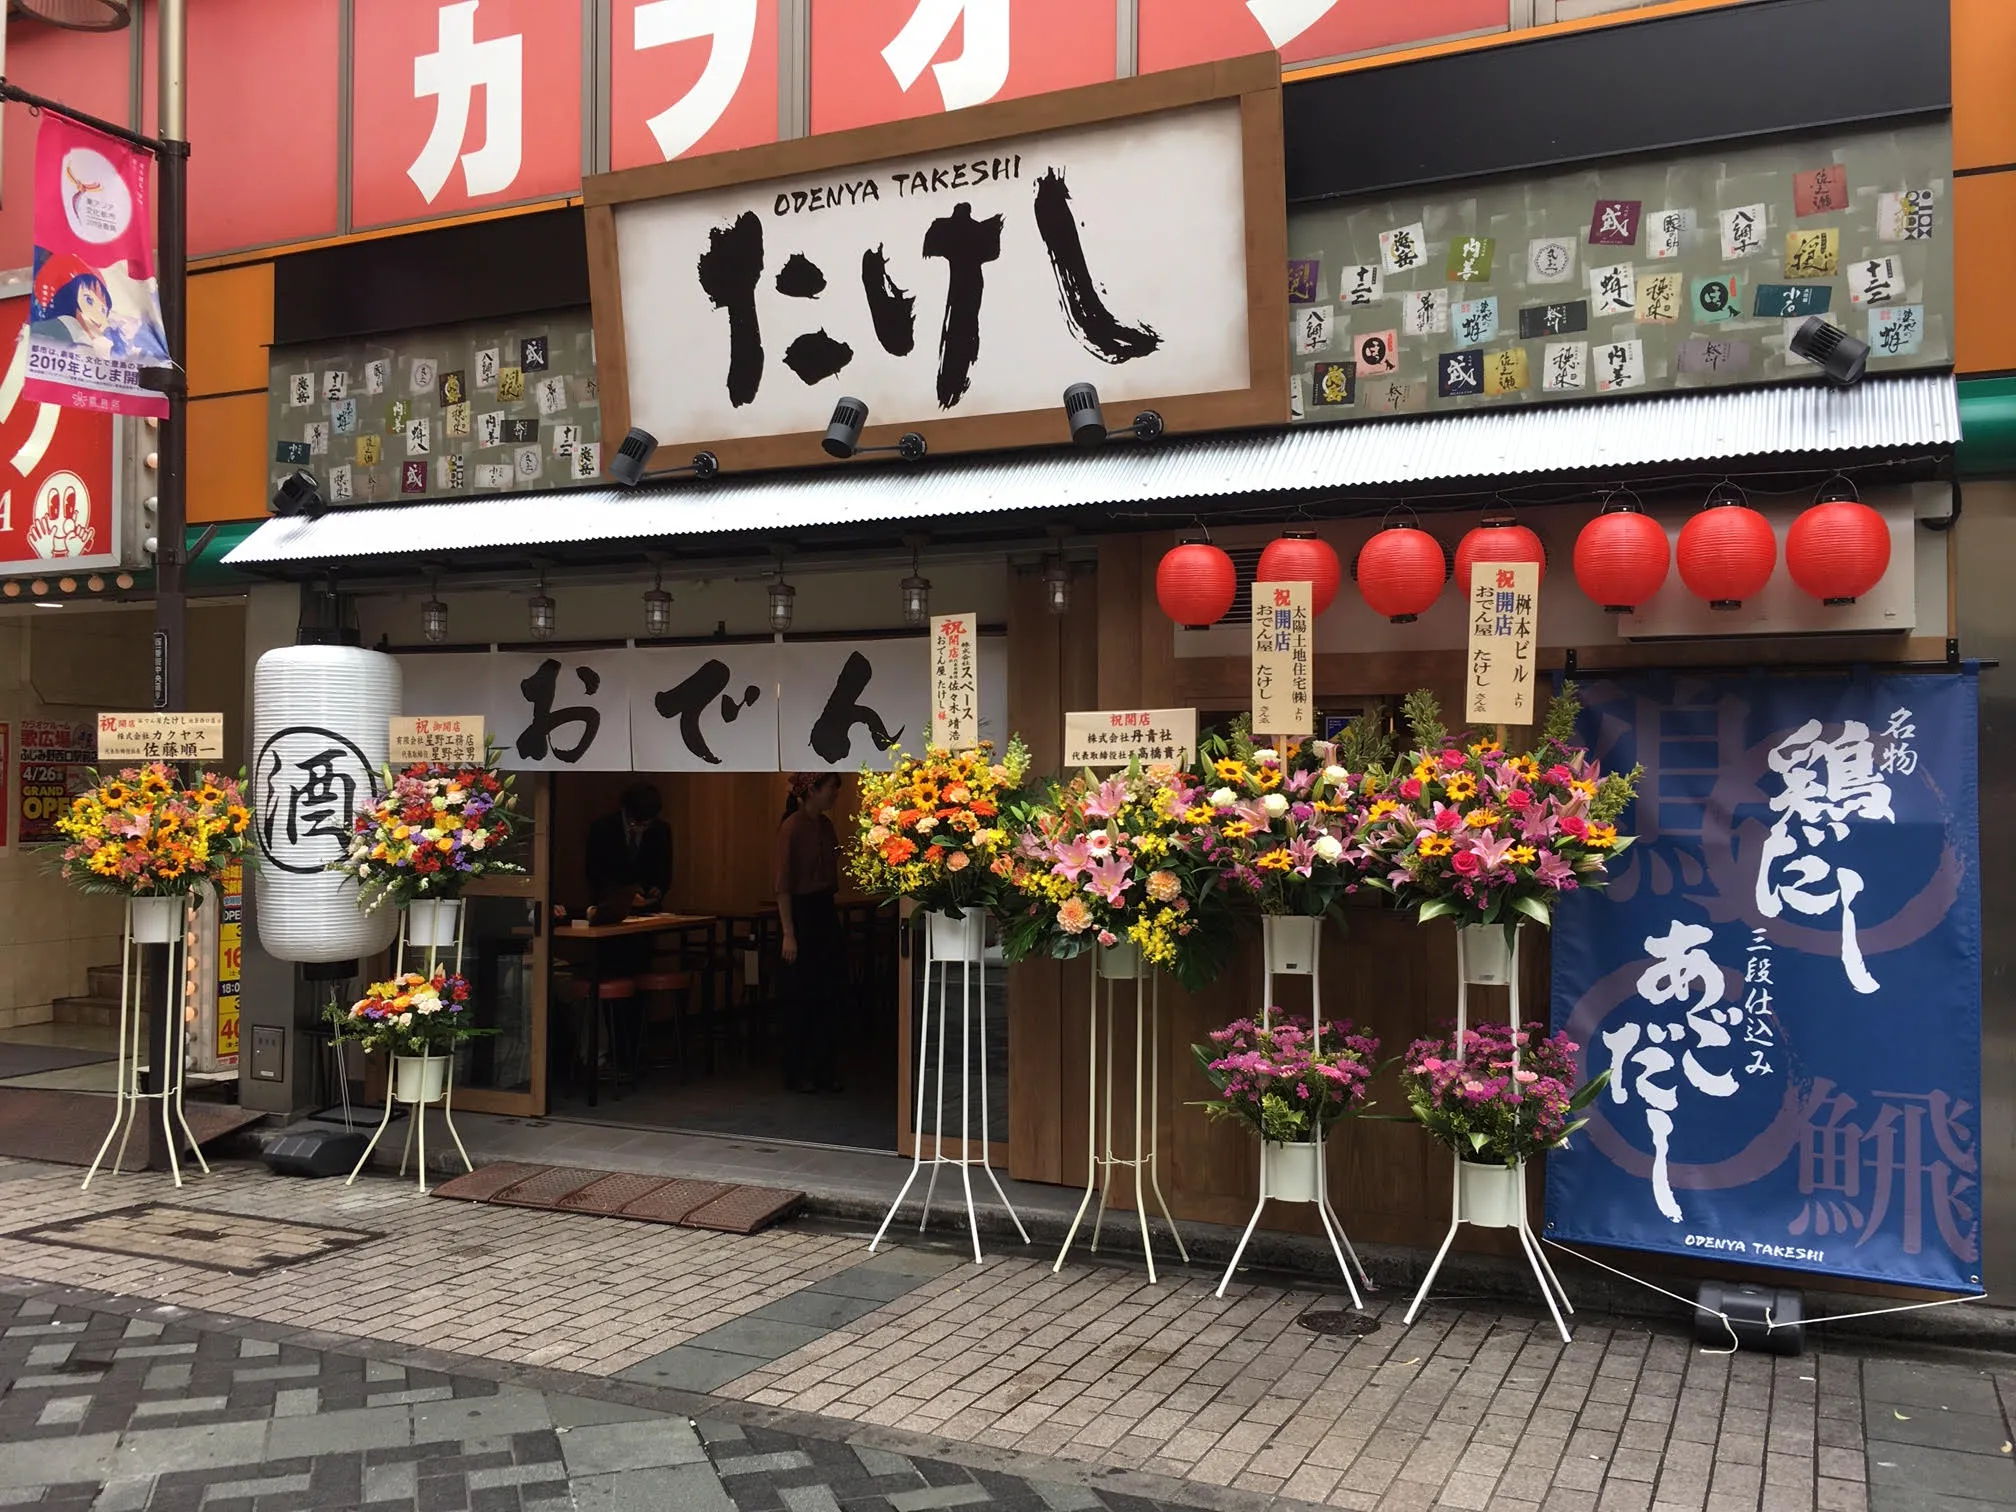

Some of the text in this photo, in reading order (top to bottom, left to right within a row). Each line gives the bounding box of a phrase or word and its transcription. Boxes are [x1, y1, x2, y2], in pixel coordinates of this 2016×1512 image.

[774, 155, 1021, 216] ODENYA TAKESHI
[697, 166, 1165, 411] たけし
[1474, 586, 1494, 637] おでん屋
[1494, 569, 1515, 636] 祝 開店
[941, 619, 967, 636] 祝
[1256, 605, 1273, 652] おでん屋
[1273, 588, 1291, 651] 祝 開店
[937, 635, 946, 676] おでん屋
[948, 635, 959, 659] 開店
[1513, 594, 1532, 708] 桝本ビル より
[1257, 664, 1273, 700] たけし
[1473, 650, 1491, 687] たけし
[516, 651, 905, 764] おでん
[938, 680, 946, 709] たけし
[948, 681, 960, 714] 佐々木
[100, 716, 117, 732] 祝
[416, 718, 461, 734] 祝 御開店
[1110, 712, 1150, 727] 祝開店
[1295, 707, 1302, 721] より
[117, 730, 205, 741] 株式会社カクヤス
[143, 742, 216, 757] 佐藤順一
[1088, 729, 1172, 744] 株式会社丹青社
[1880, 707, 1917, 776] 名物
[431, 747, 475, 761] 星野安男
[23, 766, 56, 781] 4/26
[22, 785, 64, 796] GRAND
[263, 749, 356, 851] 酒
[22, 797, 72, 819] OPE
[1744, 928, 1775, 1077] 三段仕込み
[1684, 1234, 1824, 1262] ODENYA TAKESHI
